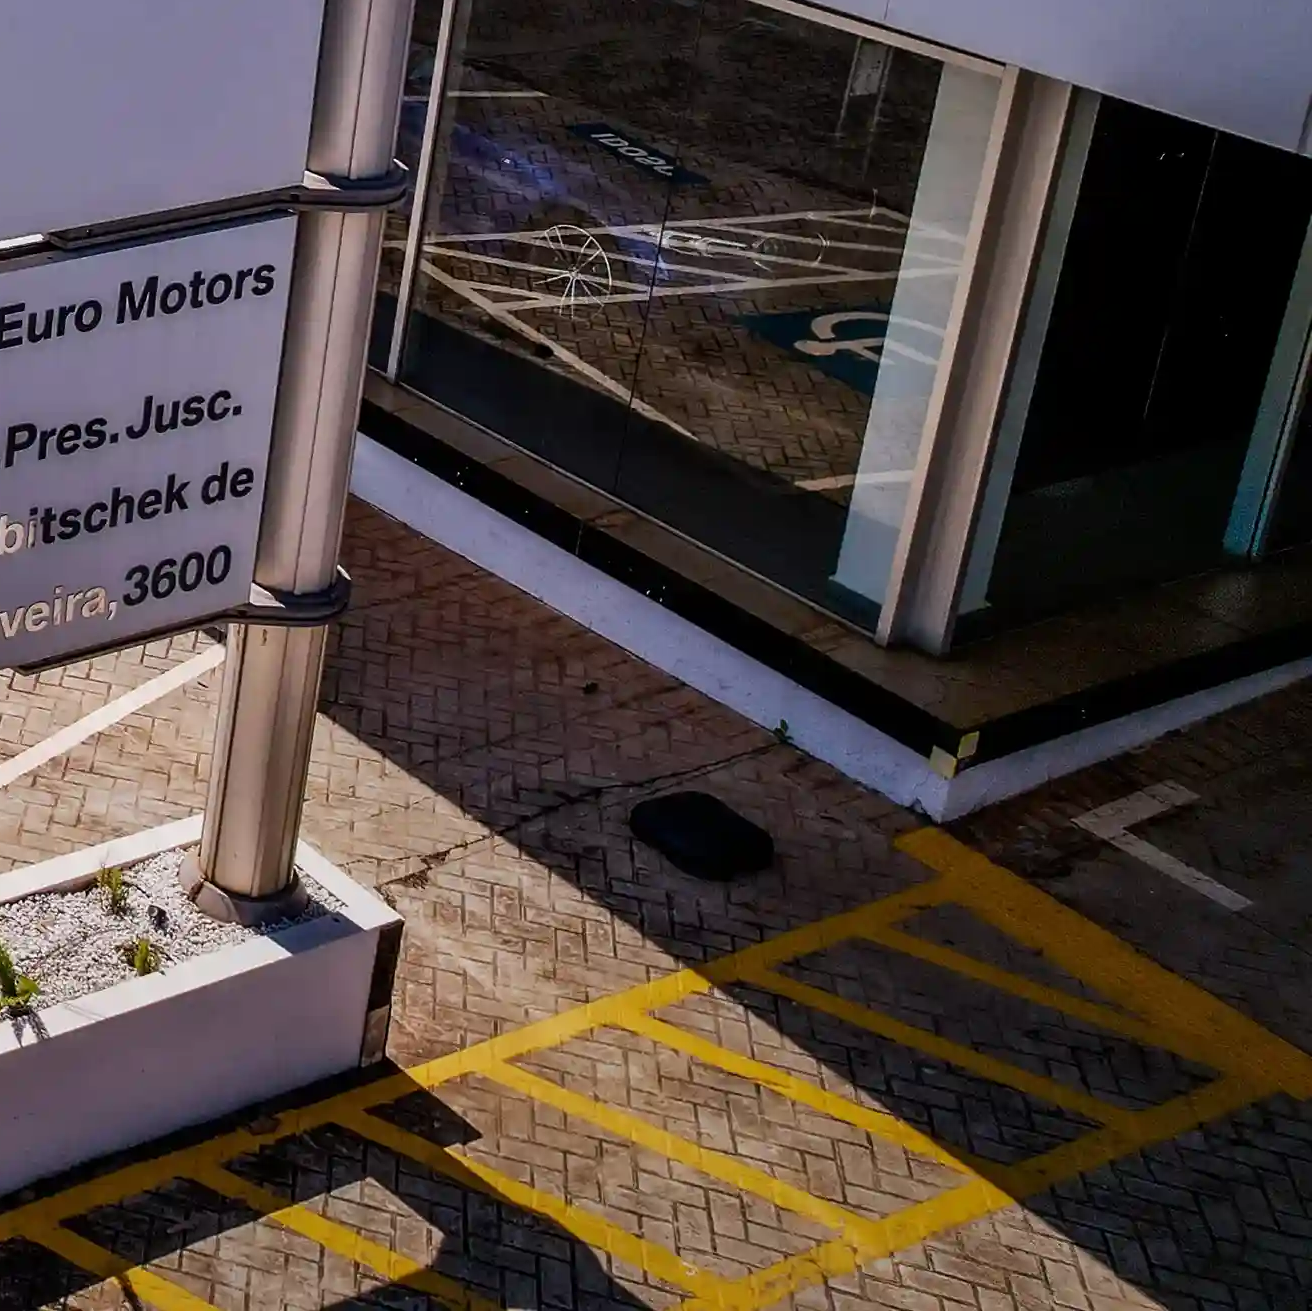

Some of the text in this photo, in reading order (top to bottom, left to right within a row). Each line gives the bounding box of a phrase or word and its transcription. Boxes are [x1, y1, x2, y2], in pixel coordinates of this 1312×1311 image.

[116, 263, 276, 324] Motors
[201, 461, 255, 506] de
[122, 544, 233, 607] 3600
